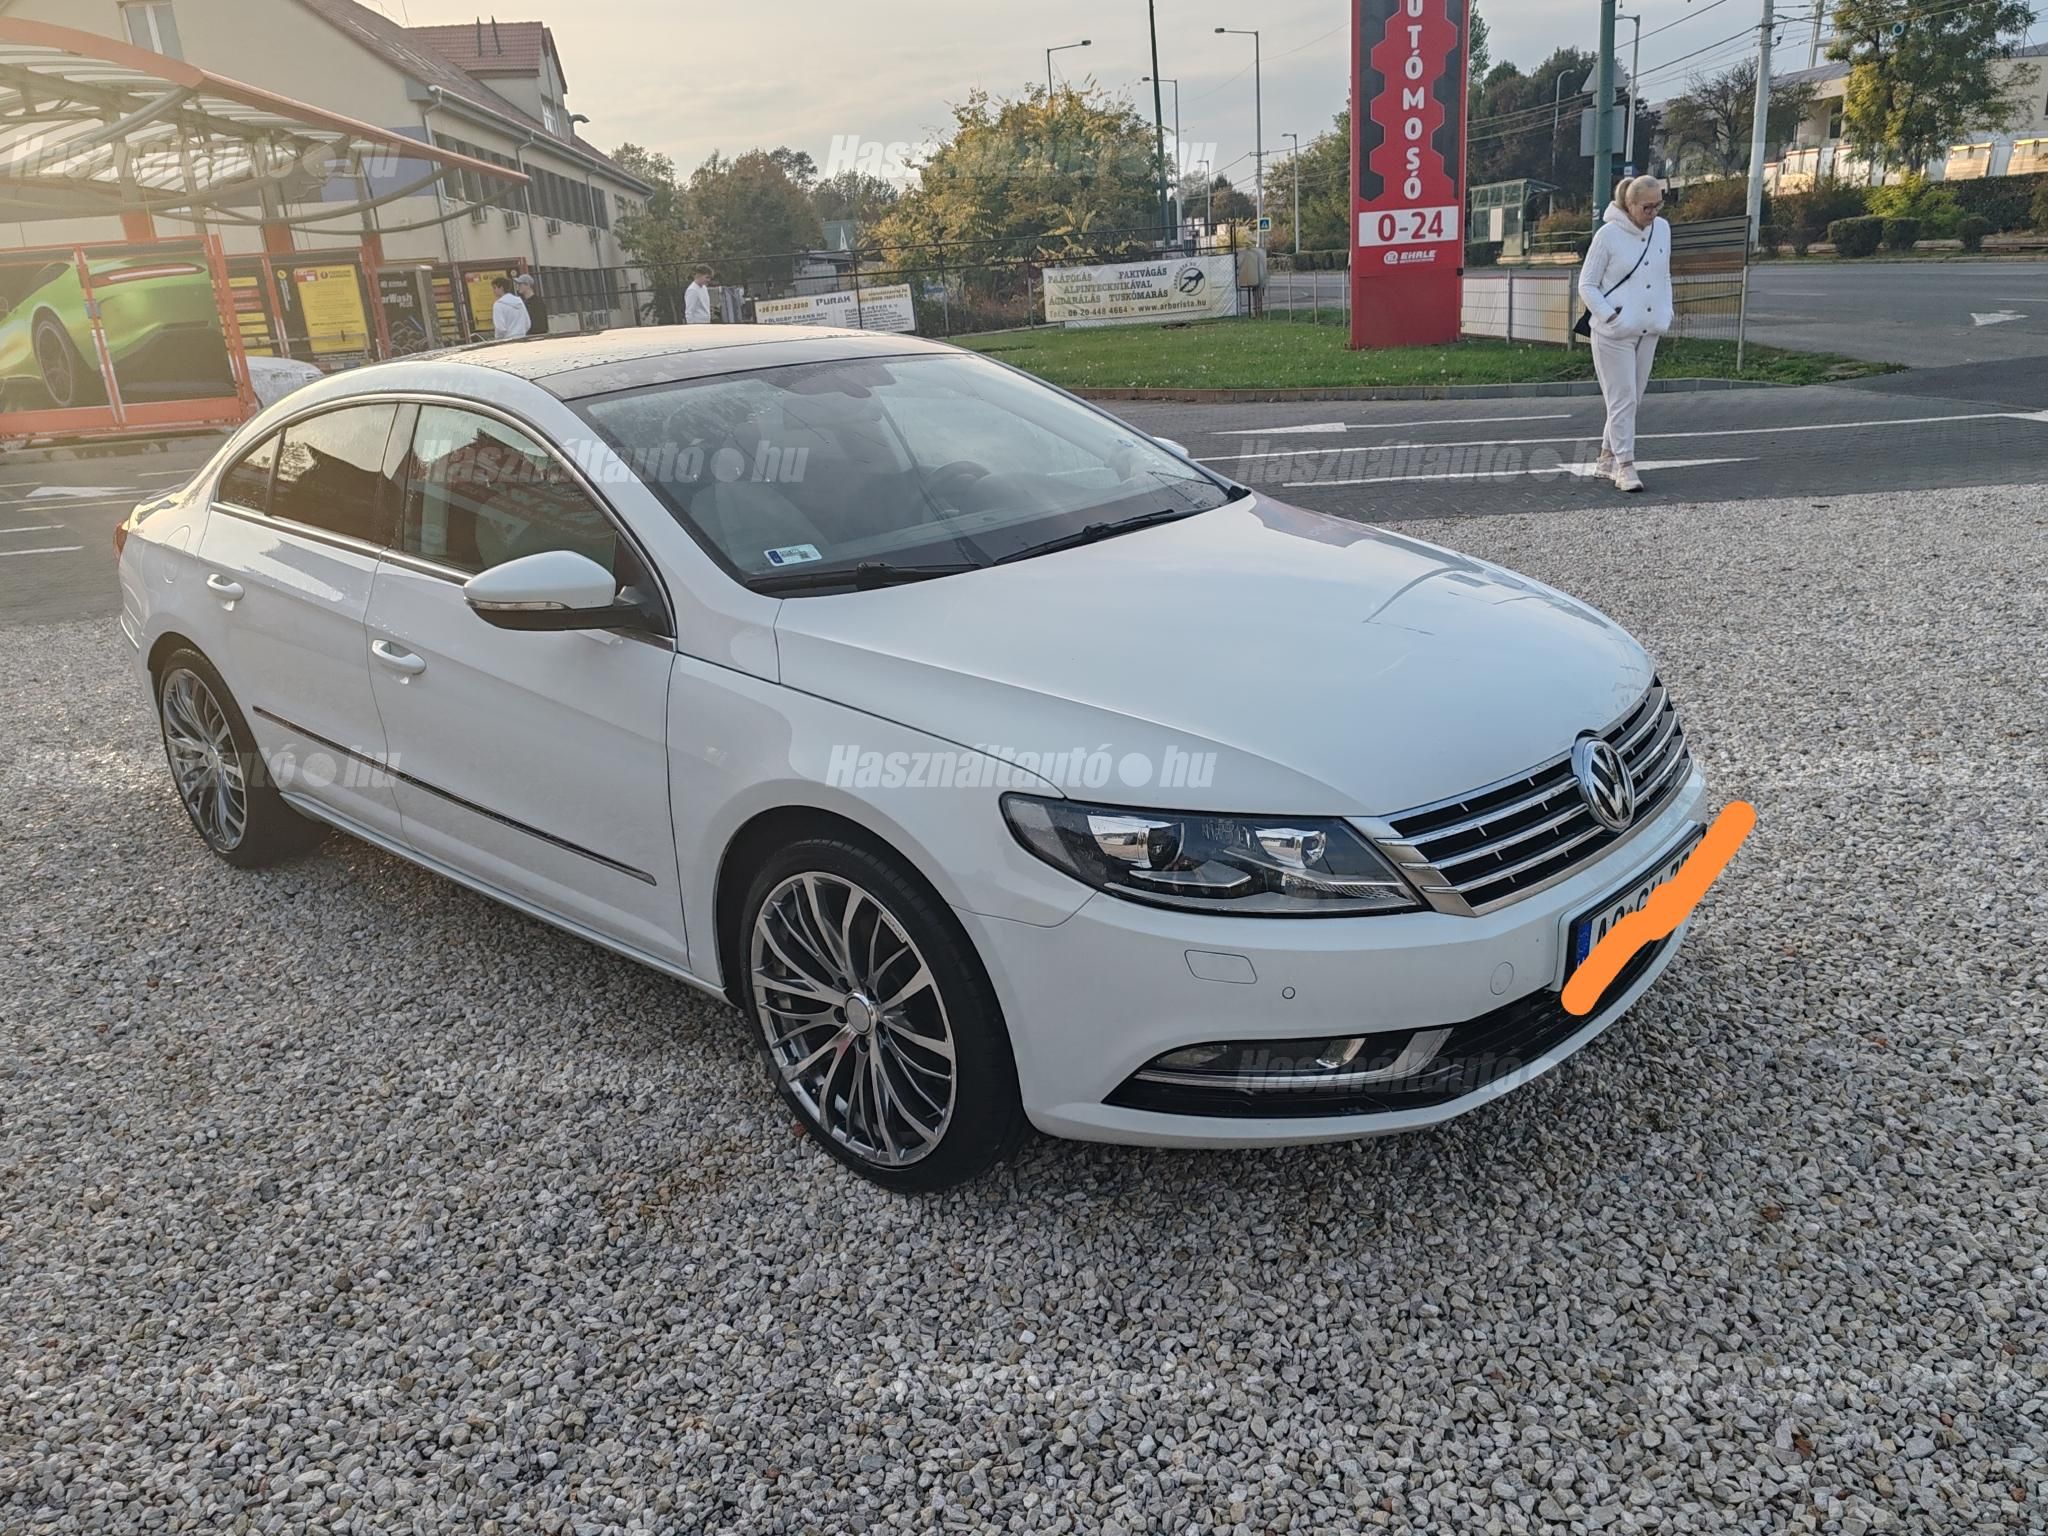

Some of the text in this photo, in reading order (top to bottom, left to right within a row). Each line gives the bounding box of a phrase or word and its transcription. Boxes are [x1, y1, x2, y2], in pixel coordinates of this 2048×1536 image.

[1377, 210, 1444, 242] 0-24
[1119, 267, 1168, 280] FAKIVÁGÁS
[1109, 289, 1169, 302] TUSKÓMARÁS
[1138, 299, 1208, 312] www.arborista.hu
